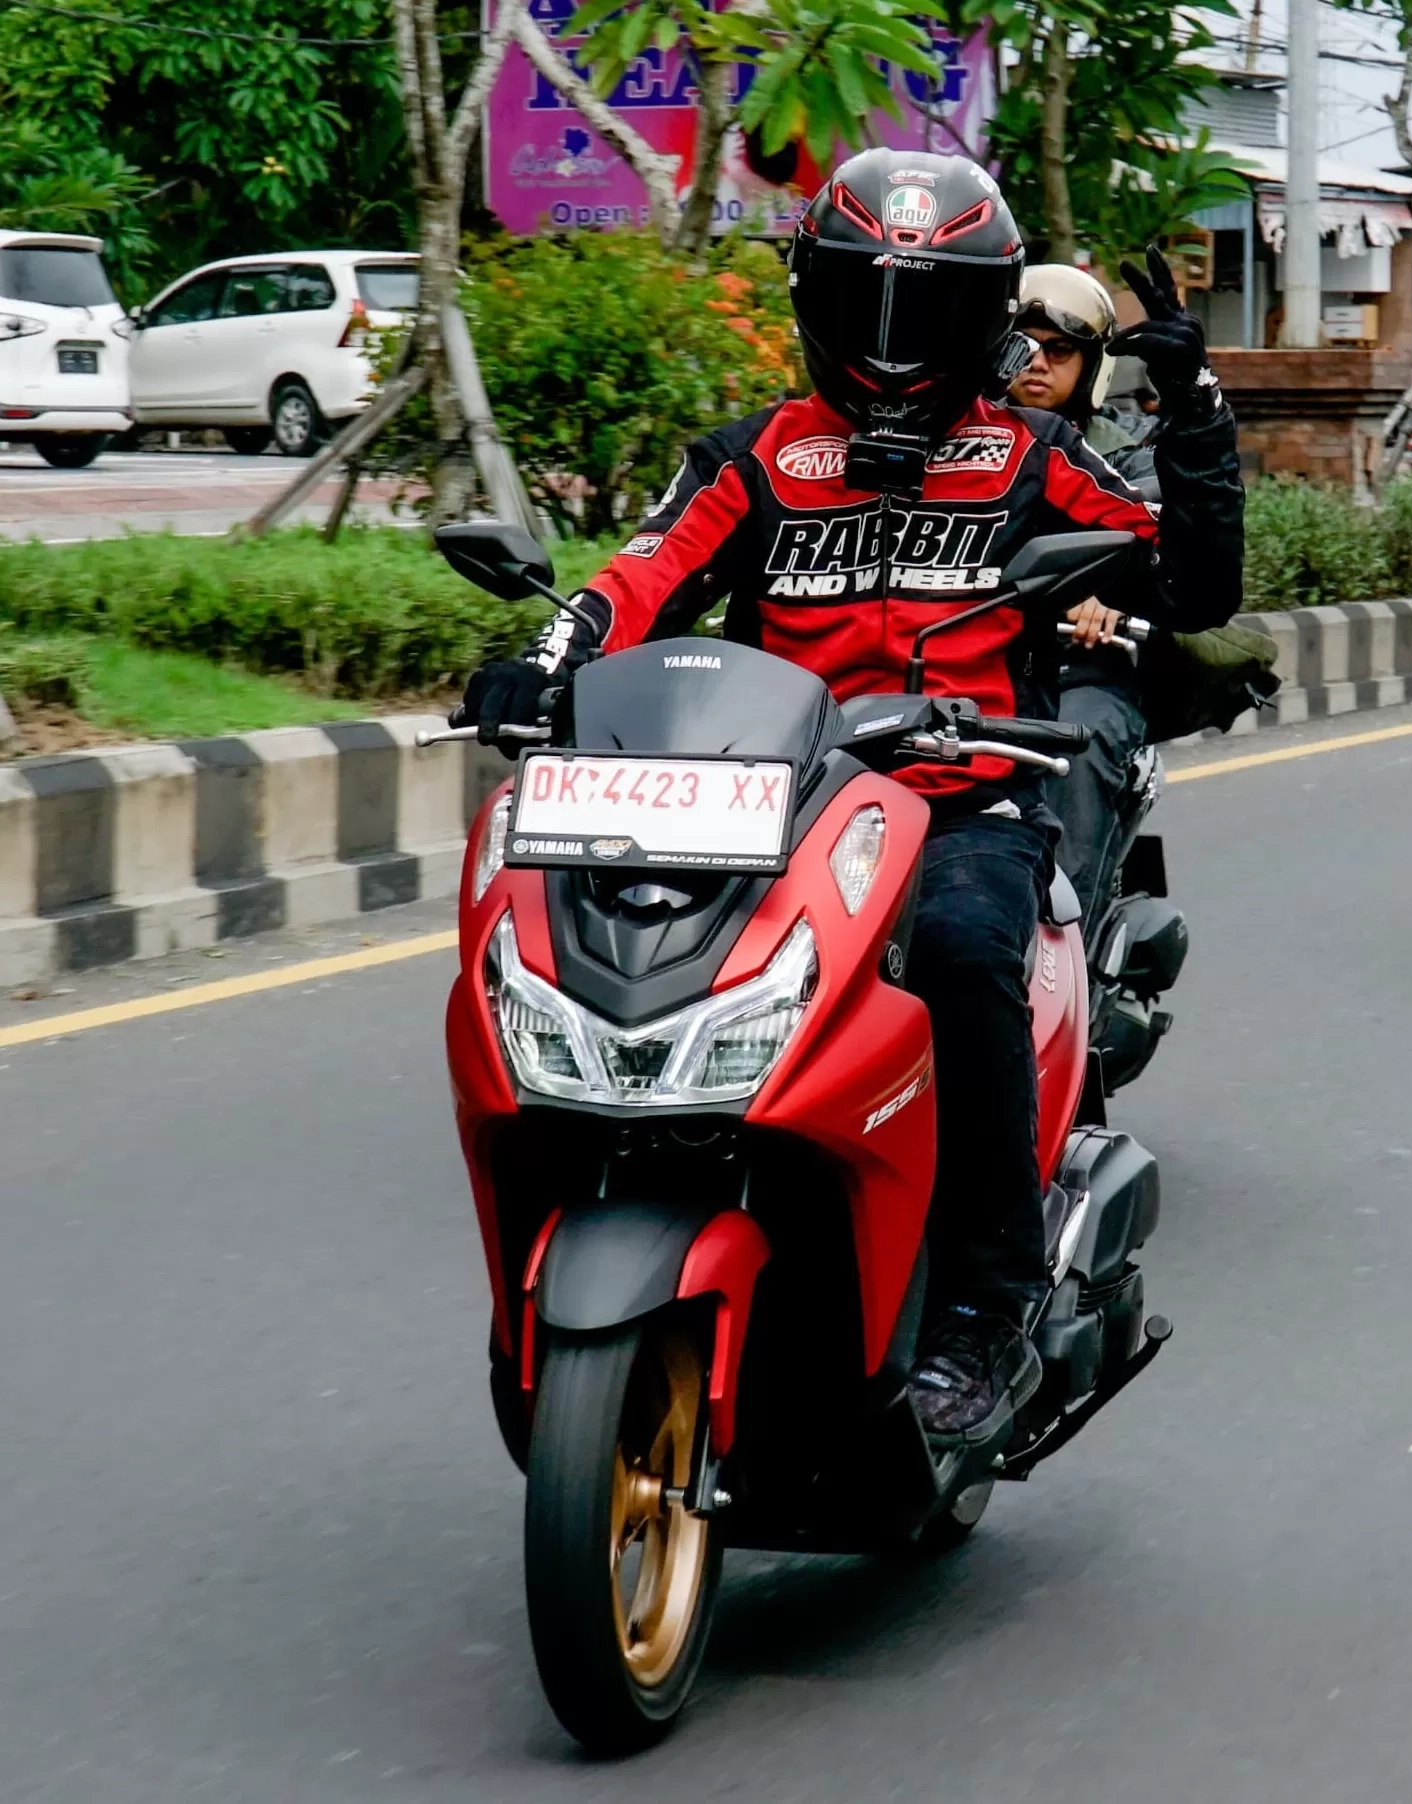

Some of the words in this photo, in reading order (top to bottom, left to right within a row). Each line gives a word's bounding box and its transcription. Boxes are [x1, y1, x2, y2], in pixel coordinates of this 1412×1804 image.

[552, 201, 629, 227] Open
[893, 207, 929, 225] agv
[764, 509, 1009, 574] RABBIT
[767, 573, 848, 597] AND
[854, 566, 1002, 593] WHEELS
[663, 655, 722, 669] YAMAHA
[531, 764, 585, 804] DK
[602, 766, 701, 809] 4423
[727, 773, 782, 812] XX
[528, 840, 584, 856] YAMAHA
[646, 854, 711, 865] SEMAKIN
[711, 857, 727, 866] DI
[727, 858, 777, 867] DEPAN
